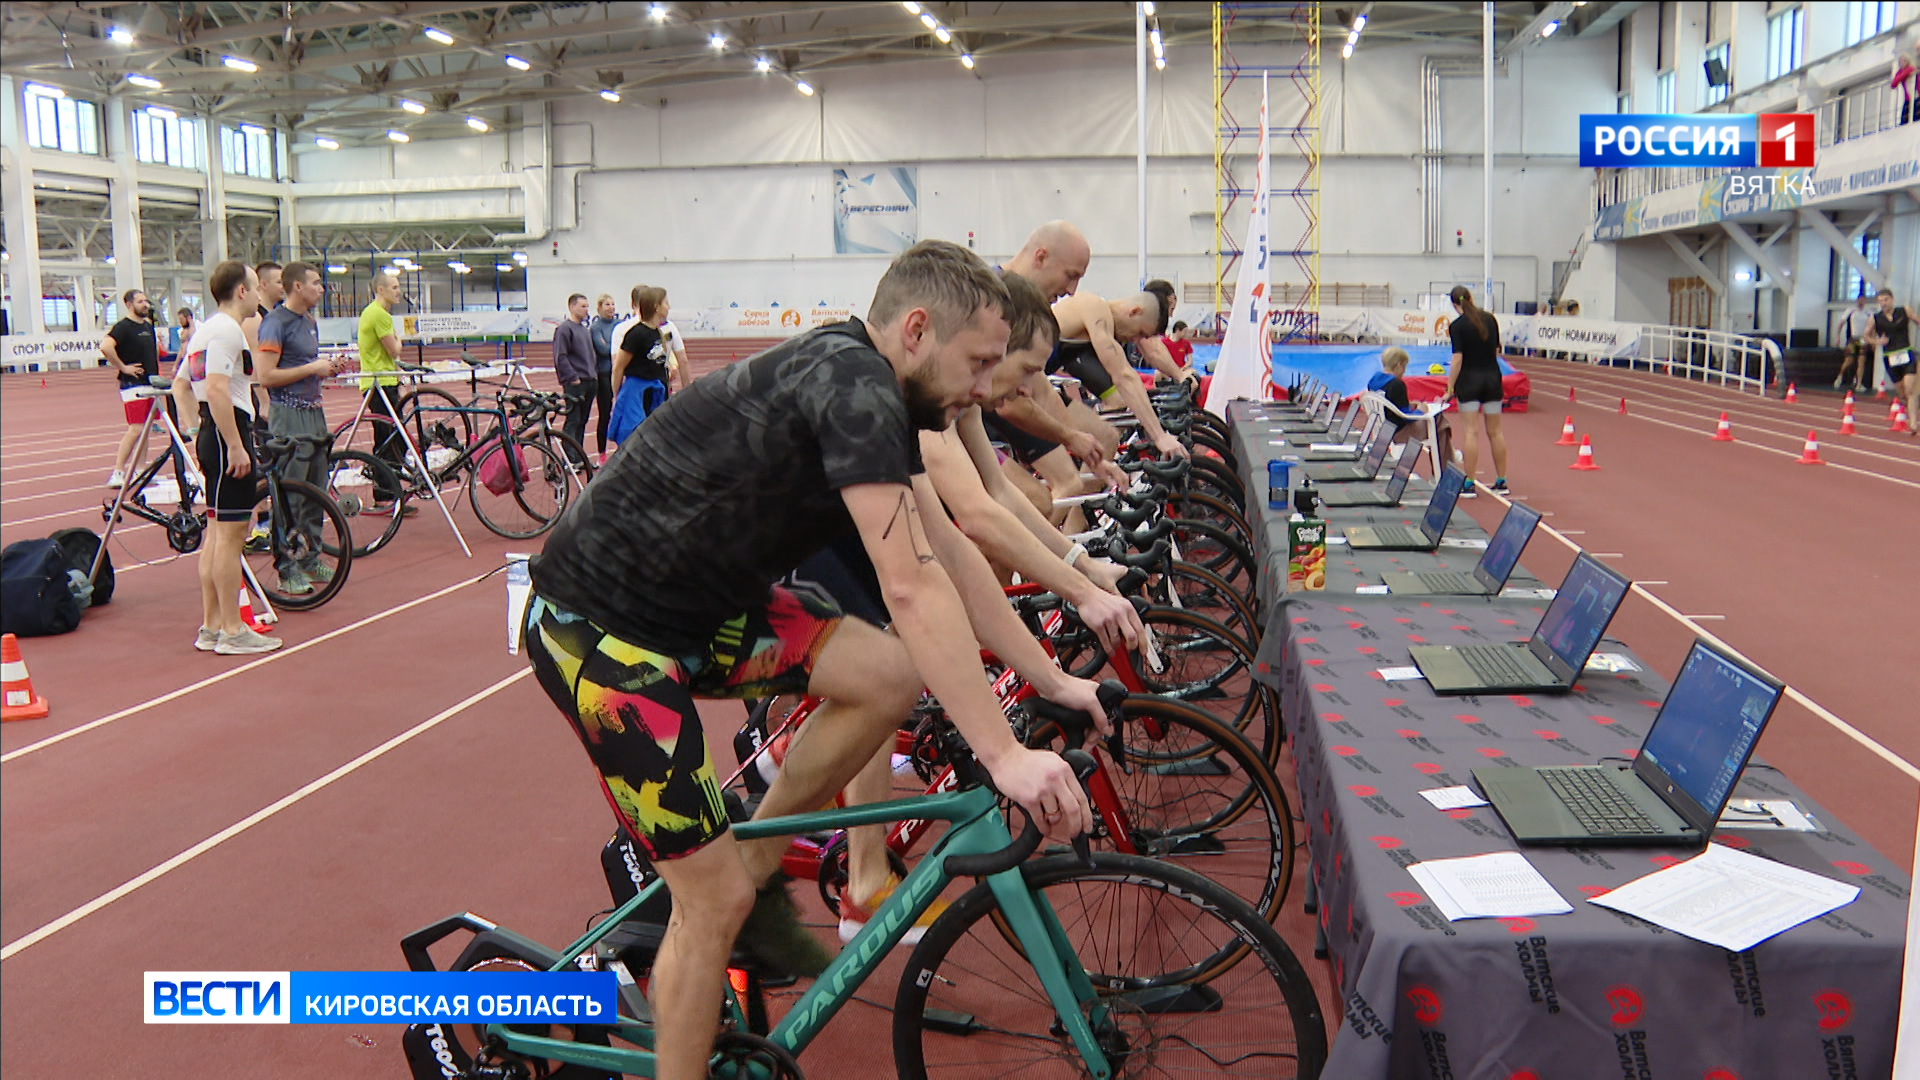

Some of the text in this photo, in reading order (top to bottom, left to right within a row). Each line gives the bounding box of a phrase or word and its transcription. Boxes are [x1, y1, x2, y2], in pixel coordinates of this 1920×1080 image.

[12, 343, 46, 355] СПОРТ
[53, 341, 92, 352] НОРМА
[1515, 939, 1544, 1002] холмы
[1529, 935, 1561, 1014] Вятские
[1726, 951, 1749, 1004] олмы
[1742, 950, 1766, 1018] ятские
[1351, 990, 1393, 1045] тские
[1432, 1030, 1454, 1080] Вятс
[1614, 1032, 1637, 1080] холм
[1629, 1030, 1653, 1080] Вятс
[1836, 1035, 1858, 1080] Вятс
